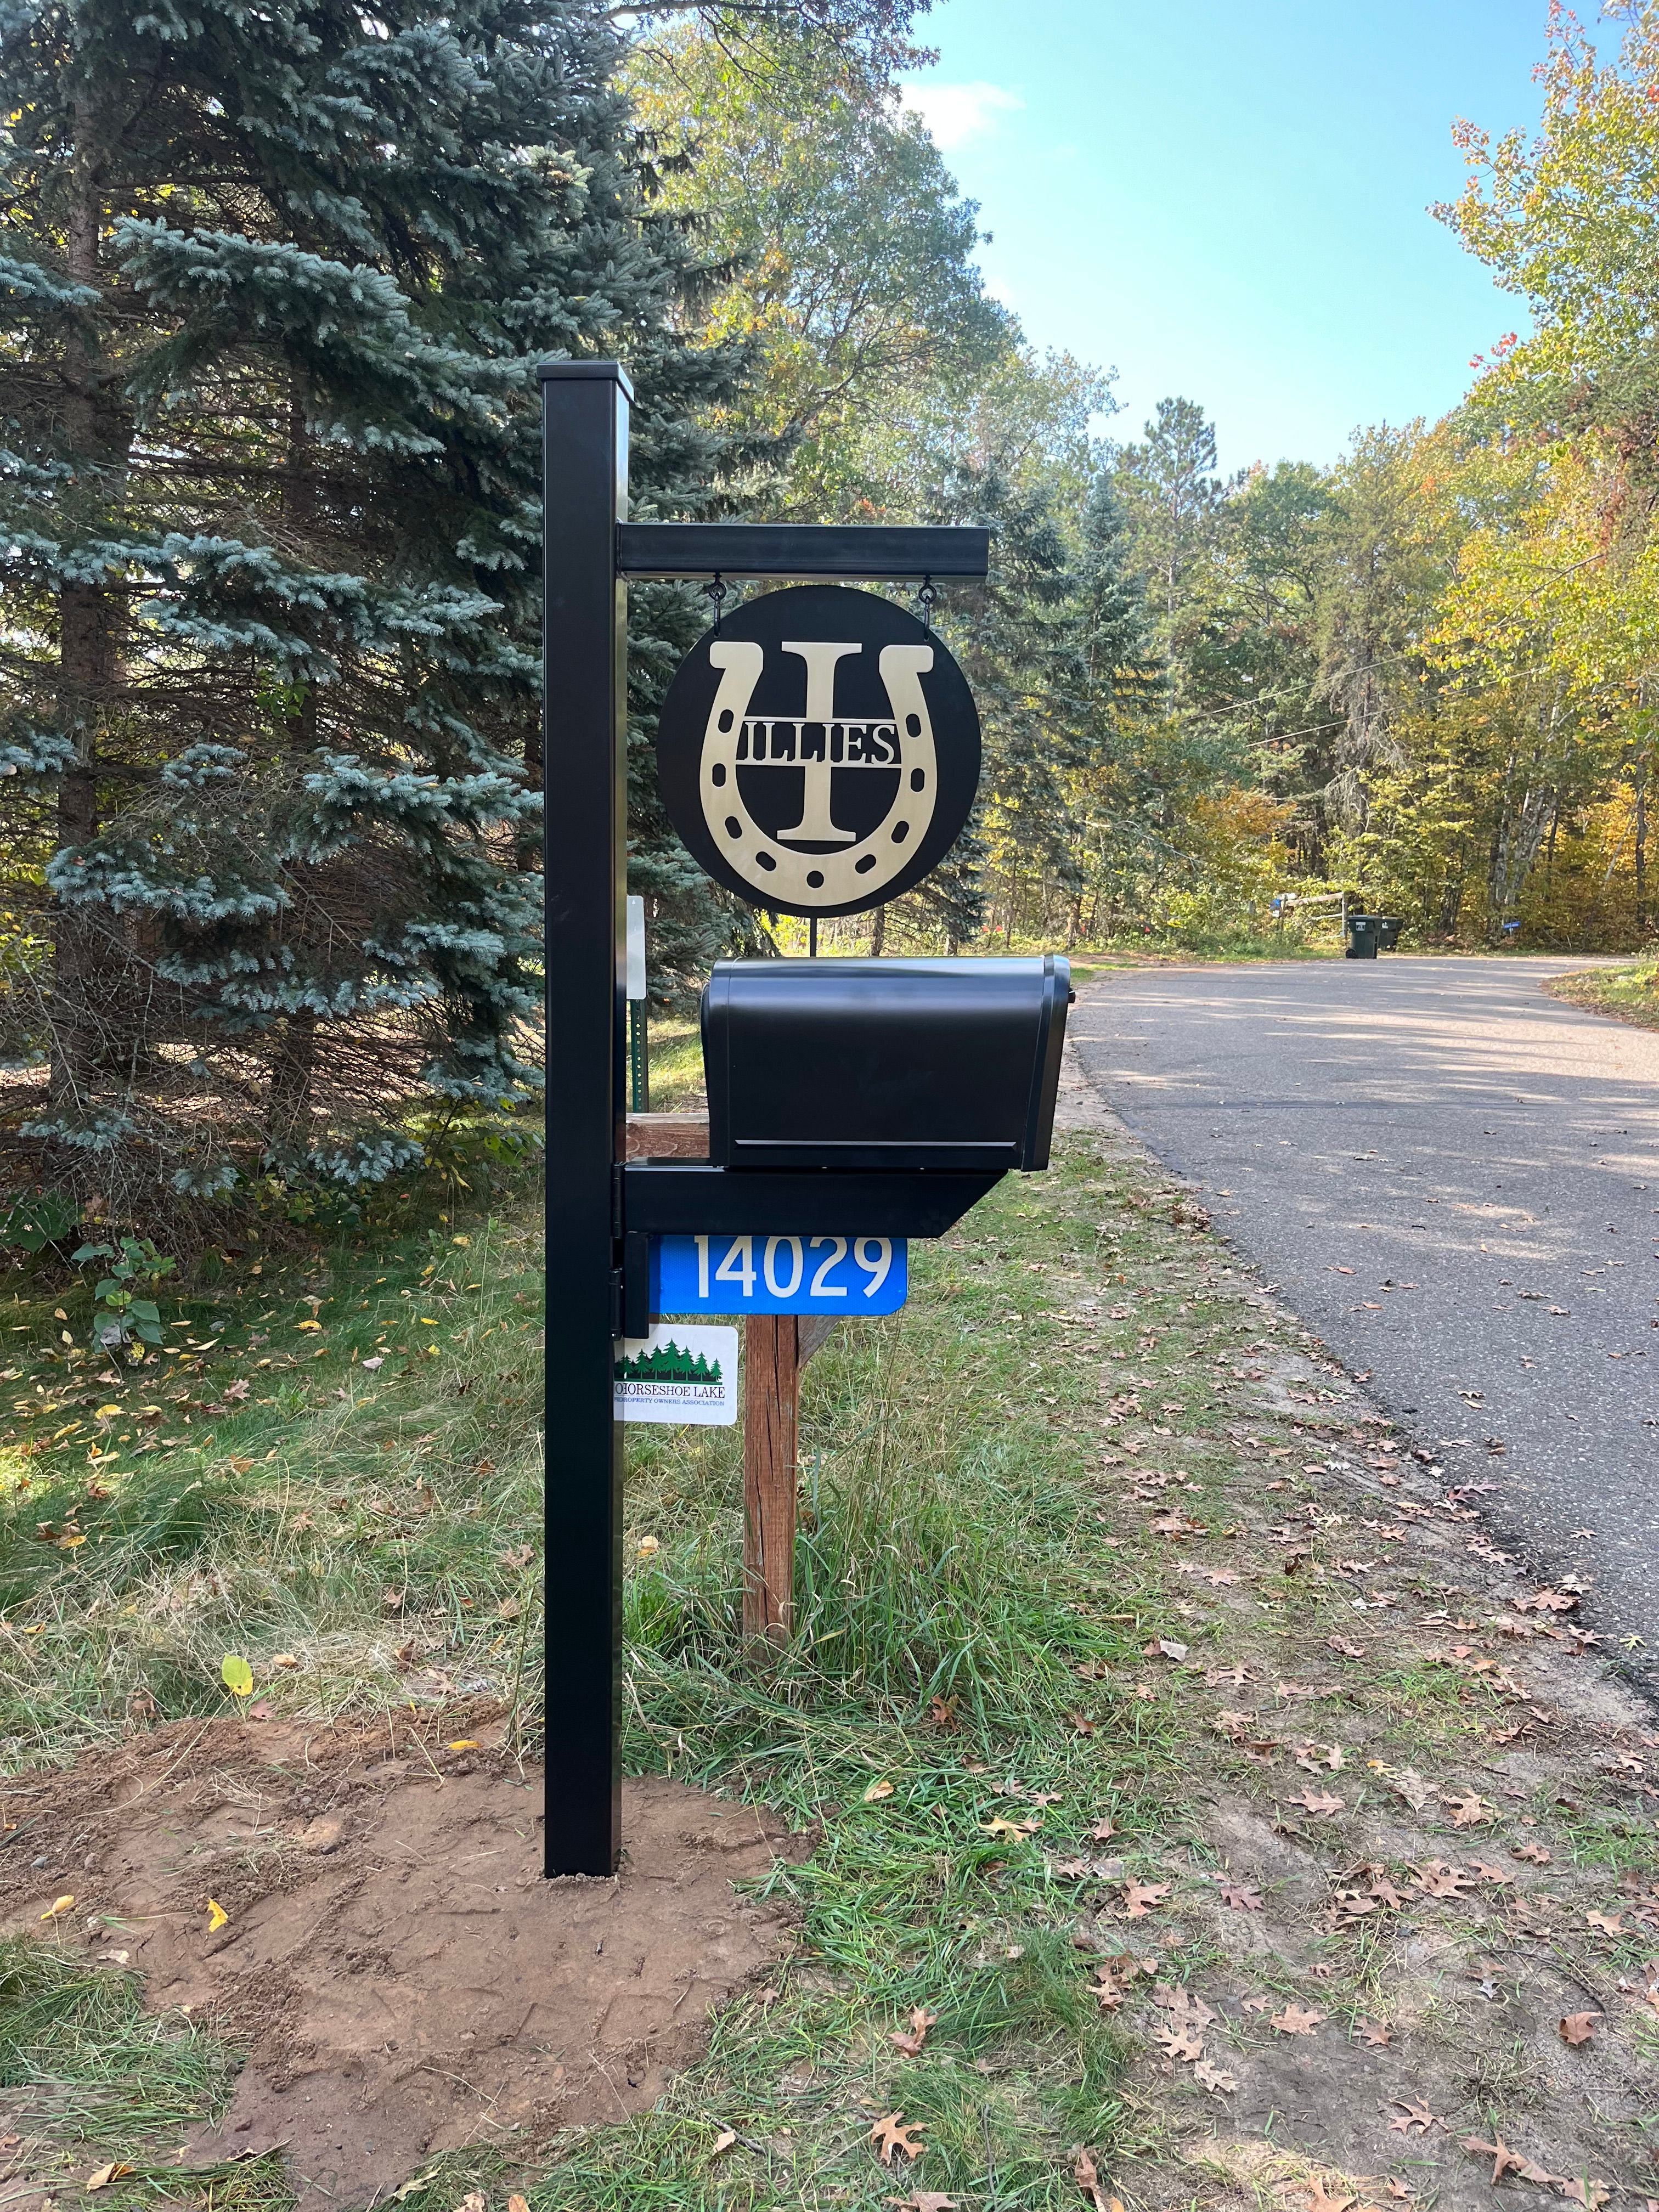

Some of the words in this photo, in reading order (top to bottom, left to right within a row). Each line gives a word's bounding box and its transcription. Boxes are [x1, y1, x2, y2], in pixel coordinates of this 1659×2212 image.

[743, 721, 896, 764] ILLIES
[695, 1235, 892, 1299] 14029
[693, 1386, 725, 1398] LAKE
